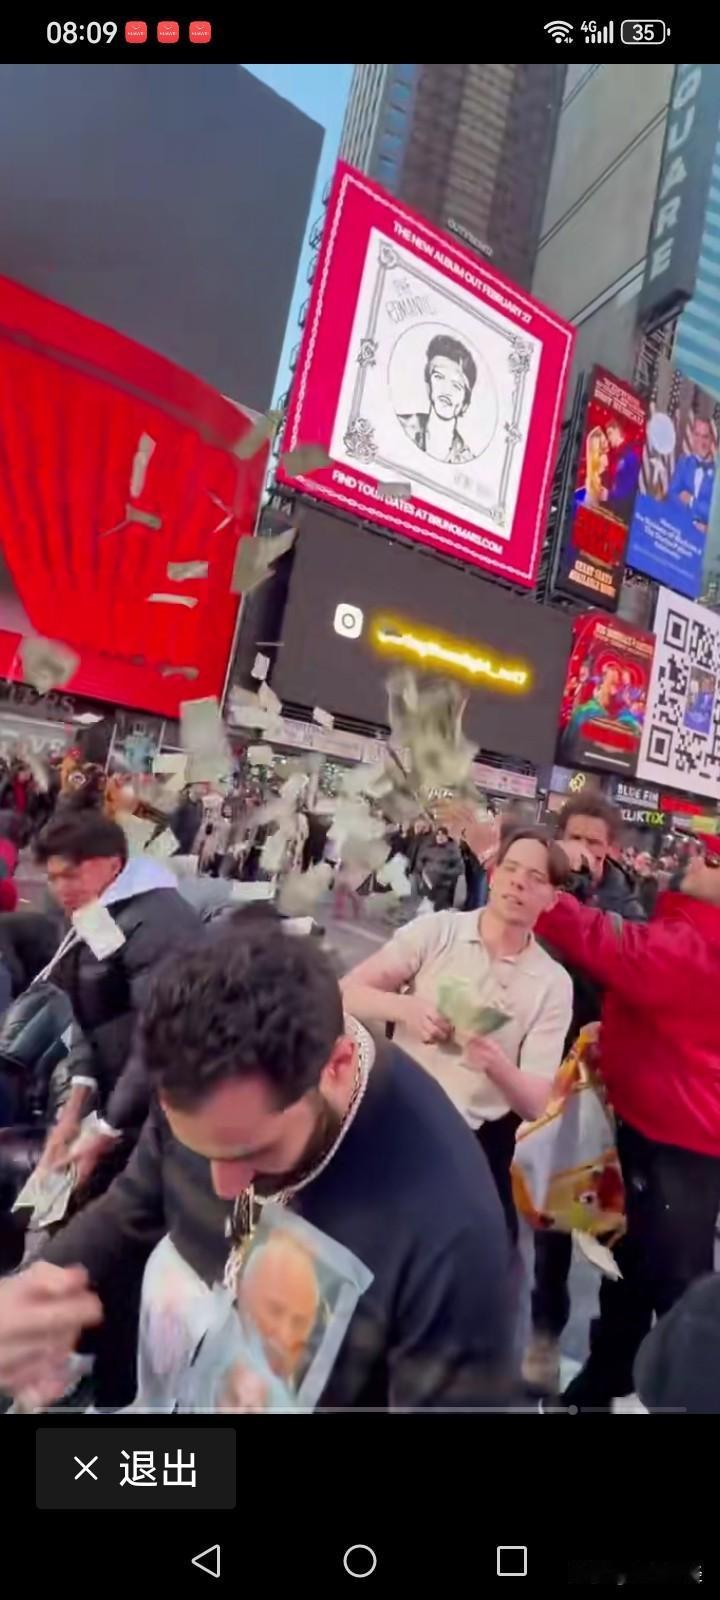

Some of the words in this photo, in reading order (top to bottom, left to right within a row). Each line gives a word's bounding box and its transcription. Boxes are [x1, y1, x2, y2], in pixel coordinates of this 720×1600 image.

[393, 220, 412, 242] THE
[412, 234, 435, 257] NEW
[433, 250, 465, 278] ALBUM
[464, 271, 484, 290] OUT
[482, 283, 522, 317] FEBRUARY
[332, 469, 358, 488] FIND
[415, 508, 429, 521] AT
[617, 784, 642, 799] BLUE
